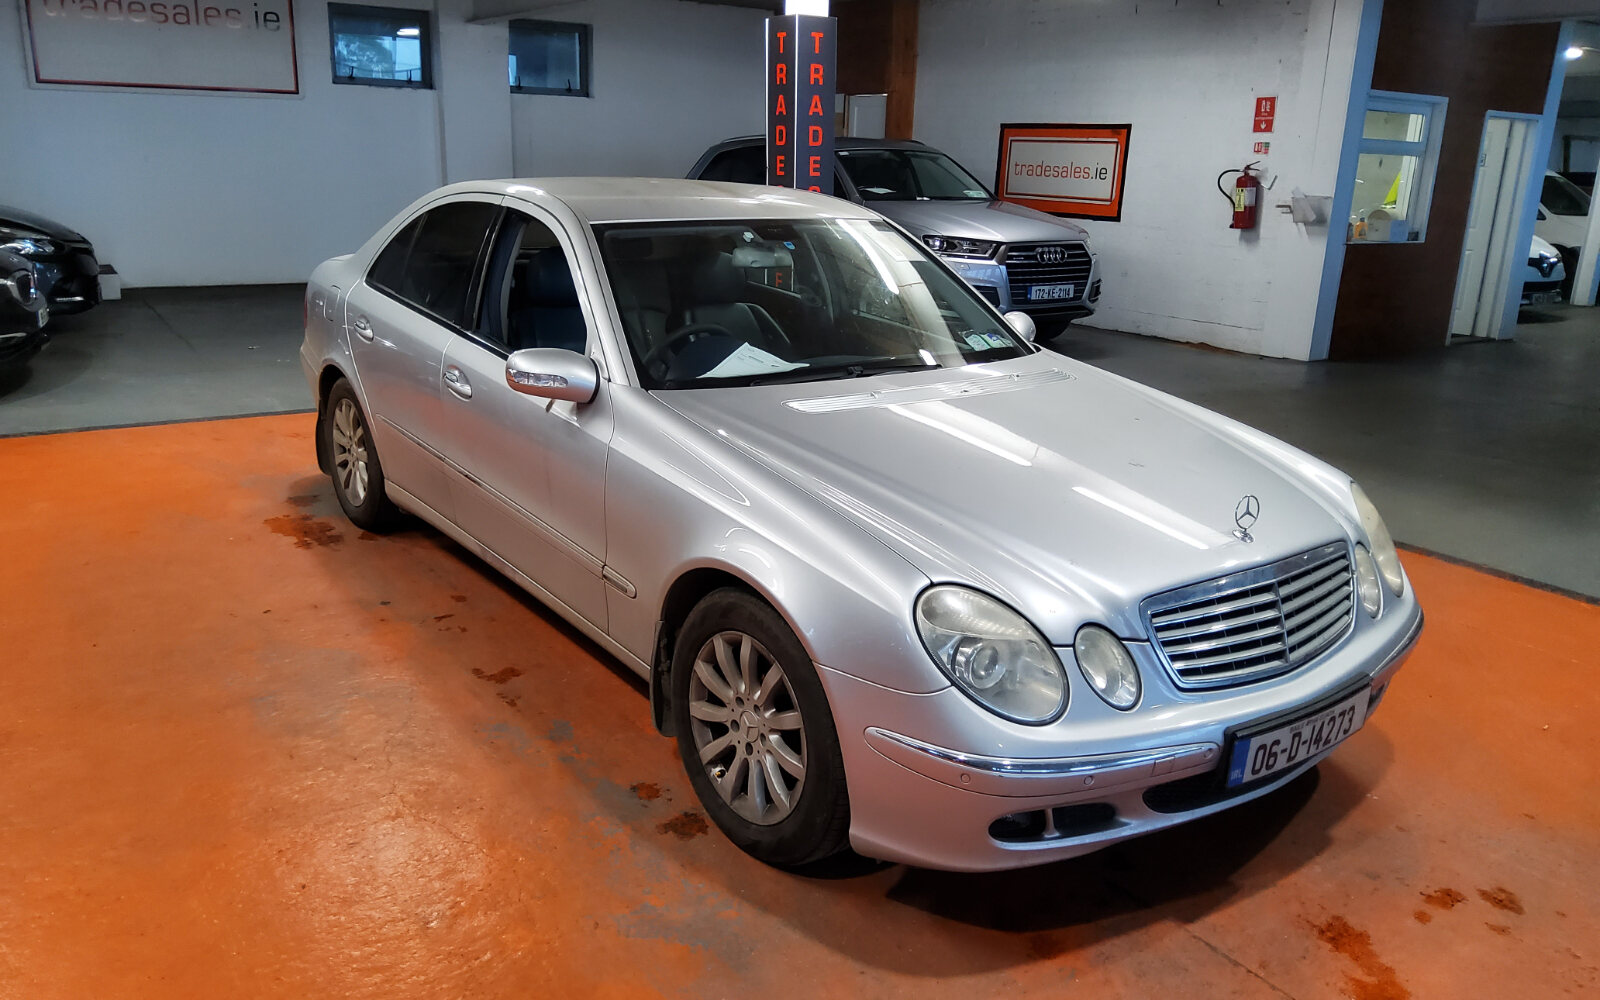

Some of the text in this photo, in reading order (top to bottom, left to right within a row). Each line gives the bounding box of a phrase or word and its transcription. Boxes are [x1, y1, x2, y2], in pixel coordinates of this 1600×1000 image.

[775, 31, 787, 188] TRADE
[1014, 160, 1108, 181] tradesales.ie
[1034, 287, 1072, 299] 172-KE-2114
[1251, 704, 1356, 776] 06-D-14273
